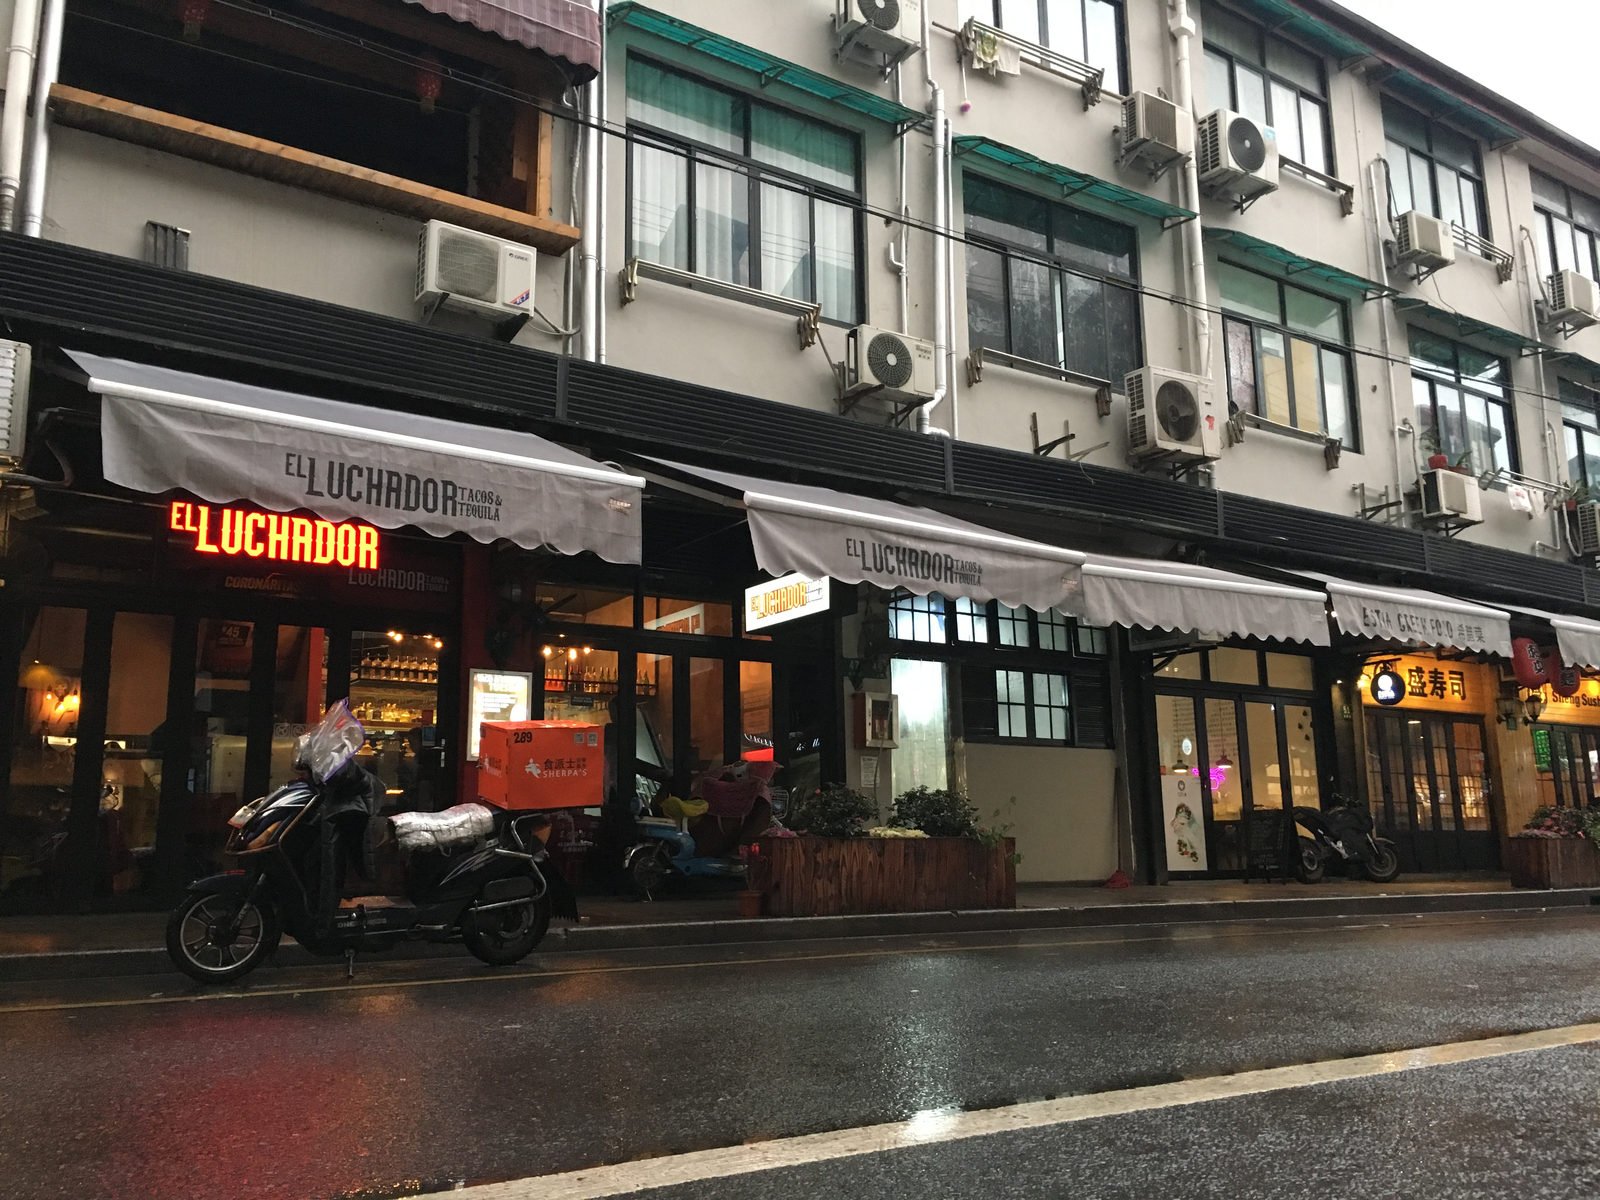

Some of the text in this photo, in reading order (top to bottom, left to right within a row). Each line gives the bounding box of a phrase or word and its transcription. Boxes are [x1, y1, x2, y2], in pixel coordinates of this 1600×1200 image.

[285, 453, 457, 516] EL LUCHADOR
[458, 486, 493, 505] TACOS
[458, 502, 500, 521] TEQUILA
[171, 502, 378, 569] EL LUCHADOR
[846, 538, 954, 584] EL LUCHADOR
[955, 559, 977, 573] TACOS
[954, 571, 982, 586] TEQUILA
[757, 581, 806, 619] LUCHADOR
[1408, 666, 1466, 700] 盛寿司
[514, 732, 534, 743] 289
[543, 769, 588, 778] SHERPA'S
